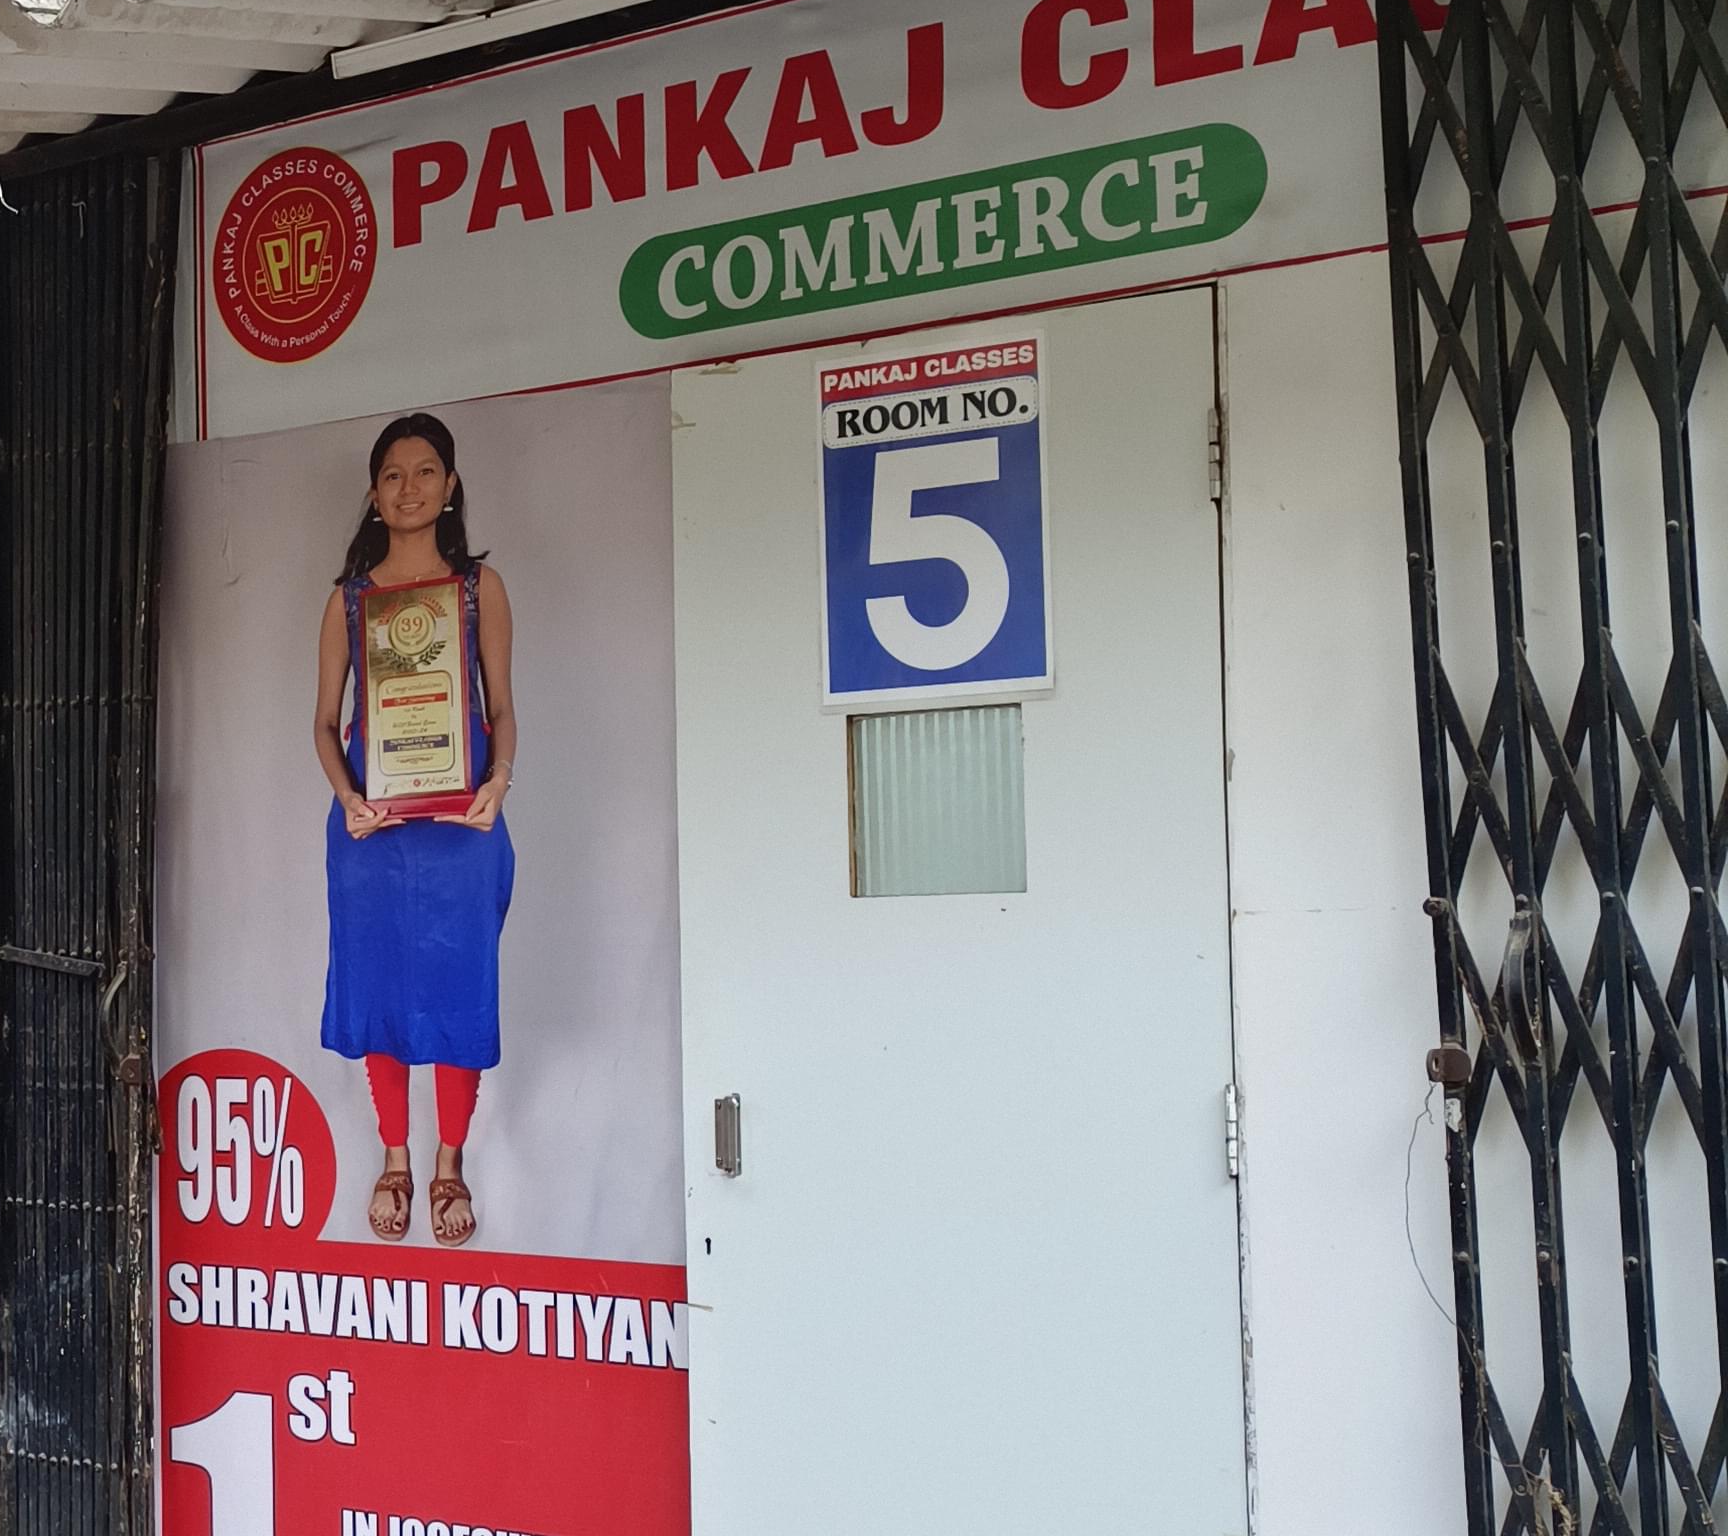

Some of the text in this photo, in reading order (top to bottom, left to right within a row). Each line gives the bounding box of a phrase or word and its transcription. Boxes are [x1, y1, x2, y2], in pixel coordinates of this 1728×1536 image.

[392, 20, 946, 249] PANKAJ
[223, 159, 369, 300] PANKAJ CLASSES COMMERCE
[263, 229, 323, 293] PC
[658, 144, 1209, 321] COMMERCE
[234, 304, 243, 317] A
[260, 331, 280, 348] With
[281, 338, 288, 349] a
[289, 320, 330, 348] Personal
[824, 344, 1035, 393] PANKAJ CLASSES
[836, 386, 1030, 439] ROOM NO.
[865, 436, 1010, 671] 5
[401, 615, 423, 634] 39
[175, 1074, 305, 1229] 95%
[168, 1261, 689, 1370] SHRAVANI KOTIYAN
